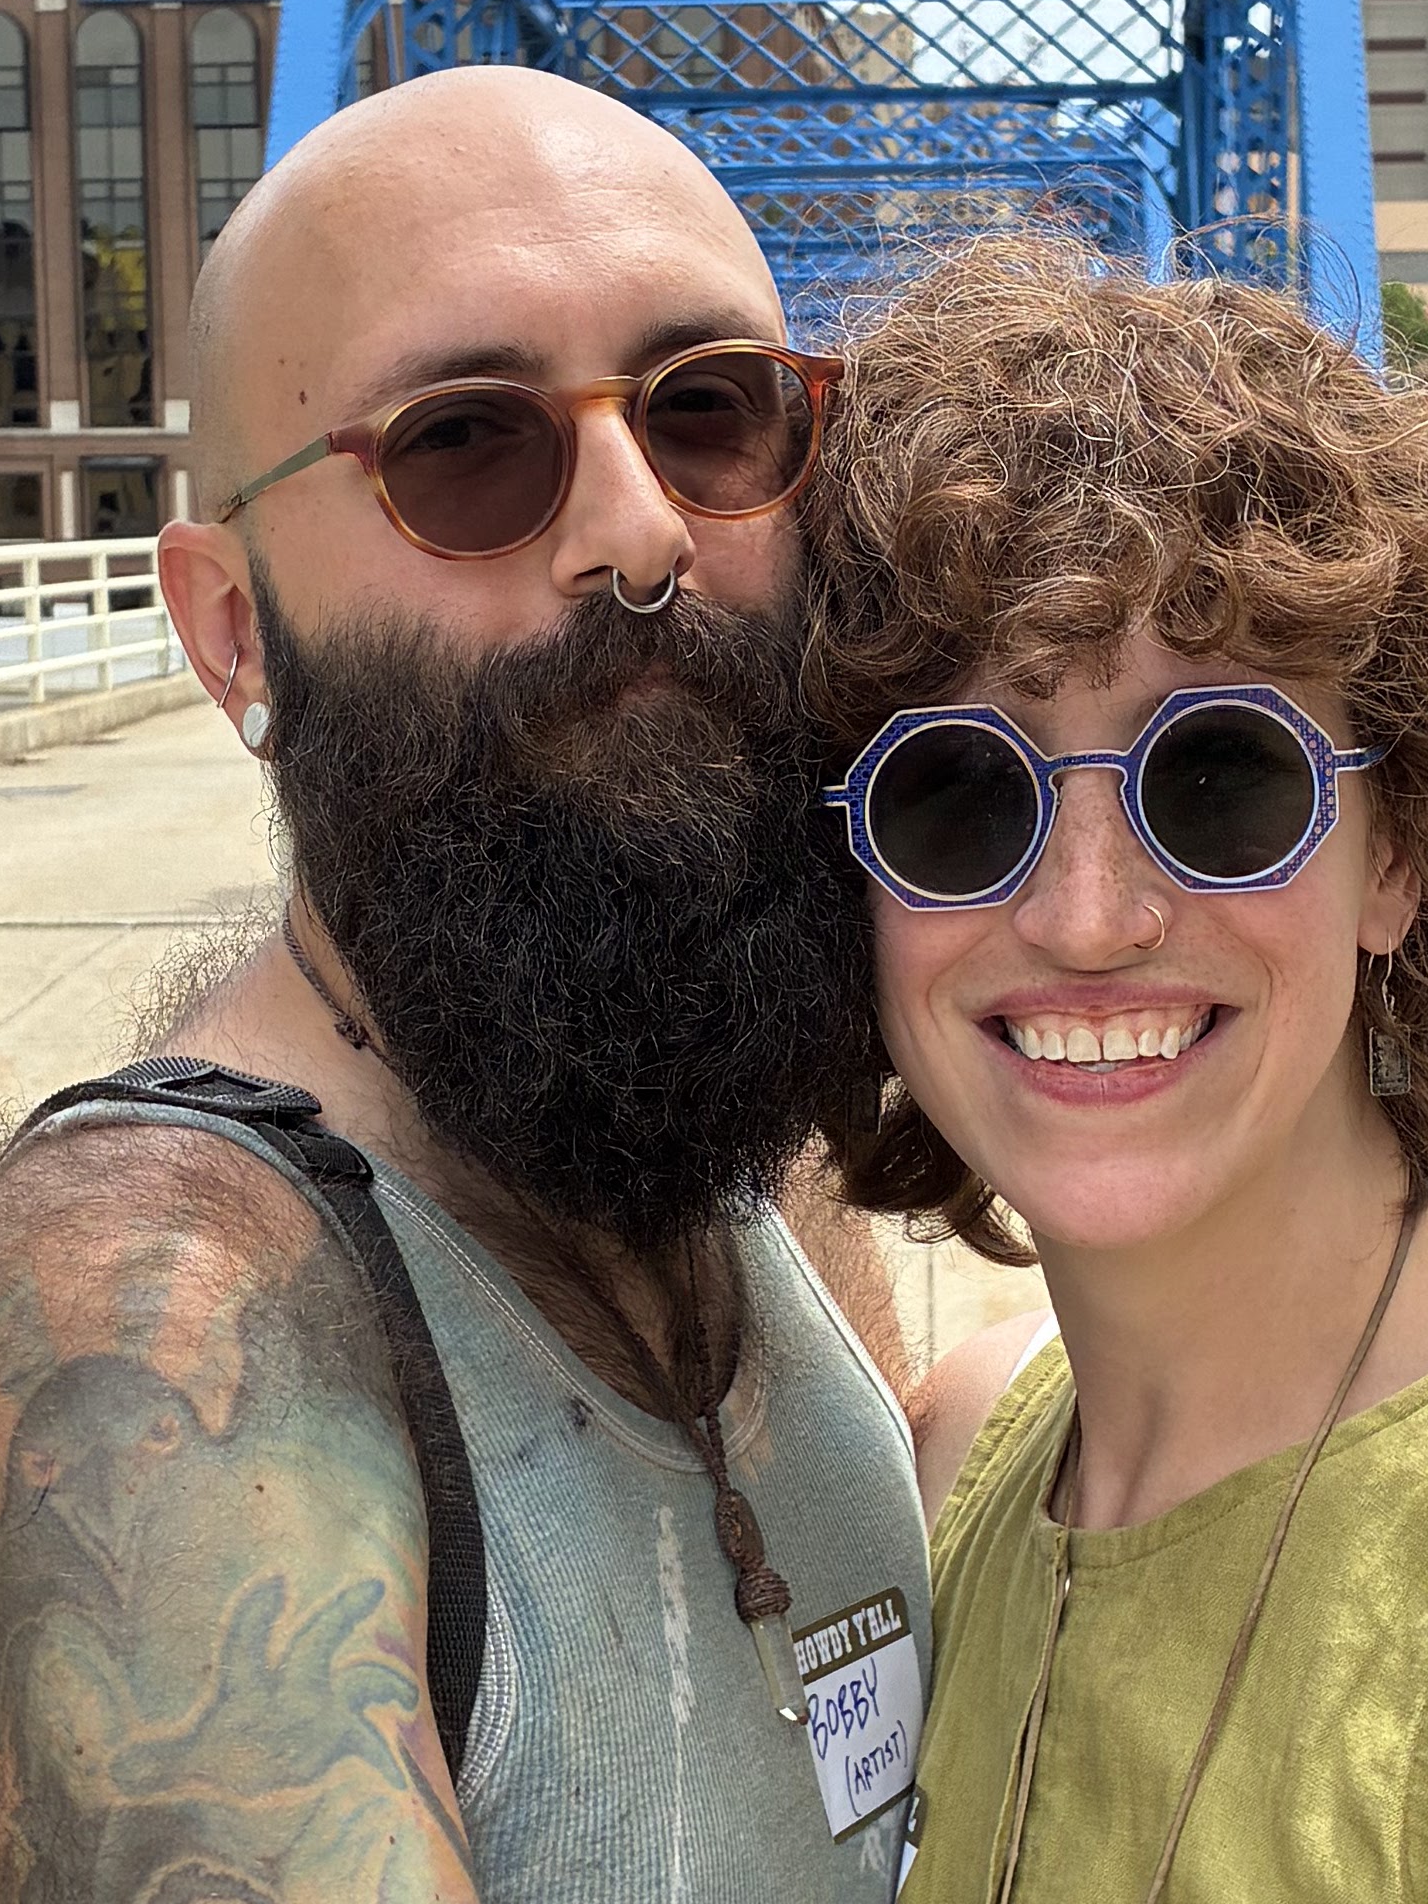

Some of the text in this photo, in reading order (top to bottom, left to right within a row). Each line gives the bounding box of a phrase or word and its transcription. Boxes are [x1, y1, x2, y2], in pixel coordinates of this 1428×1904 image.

[793, 1598, 902, 1675] HOWDY Y'ALL
[807, 1657, 880, 1761] BOBBY
[845, 1719, 908, 1817] (ARTIST)
